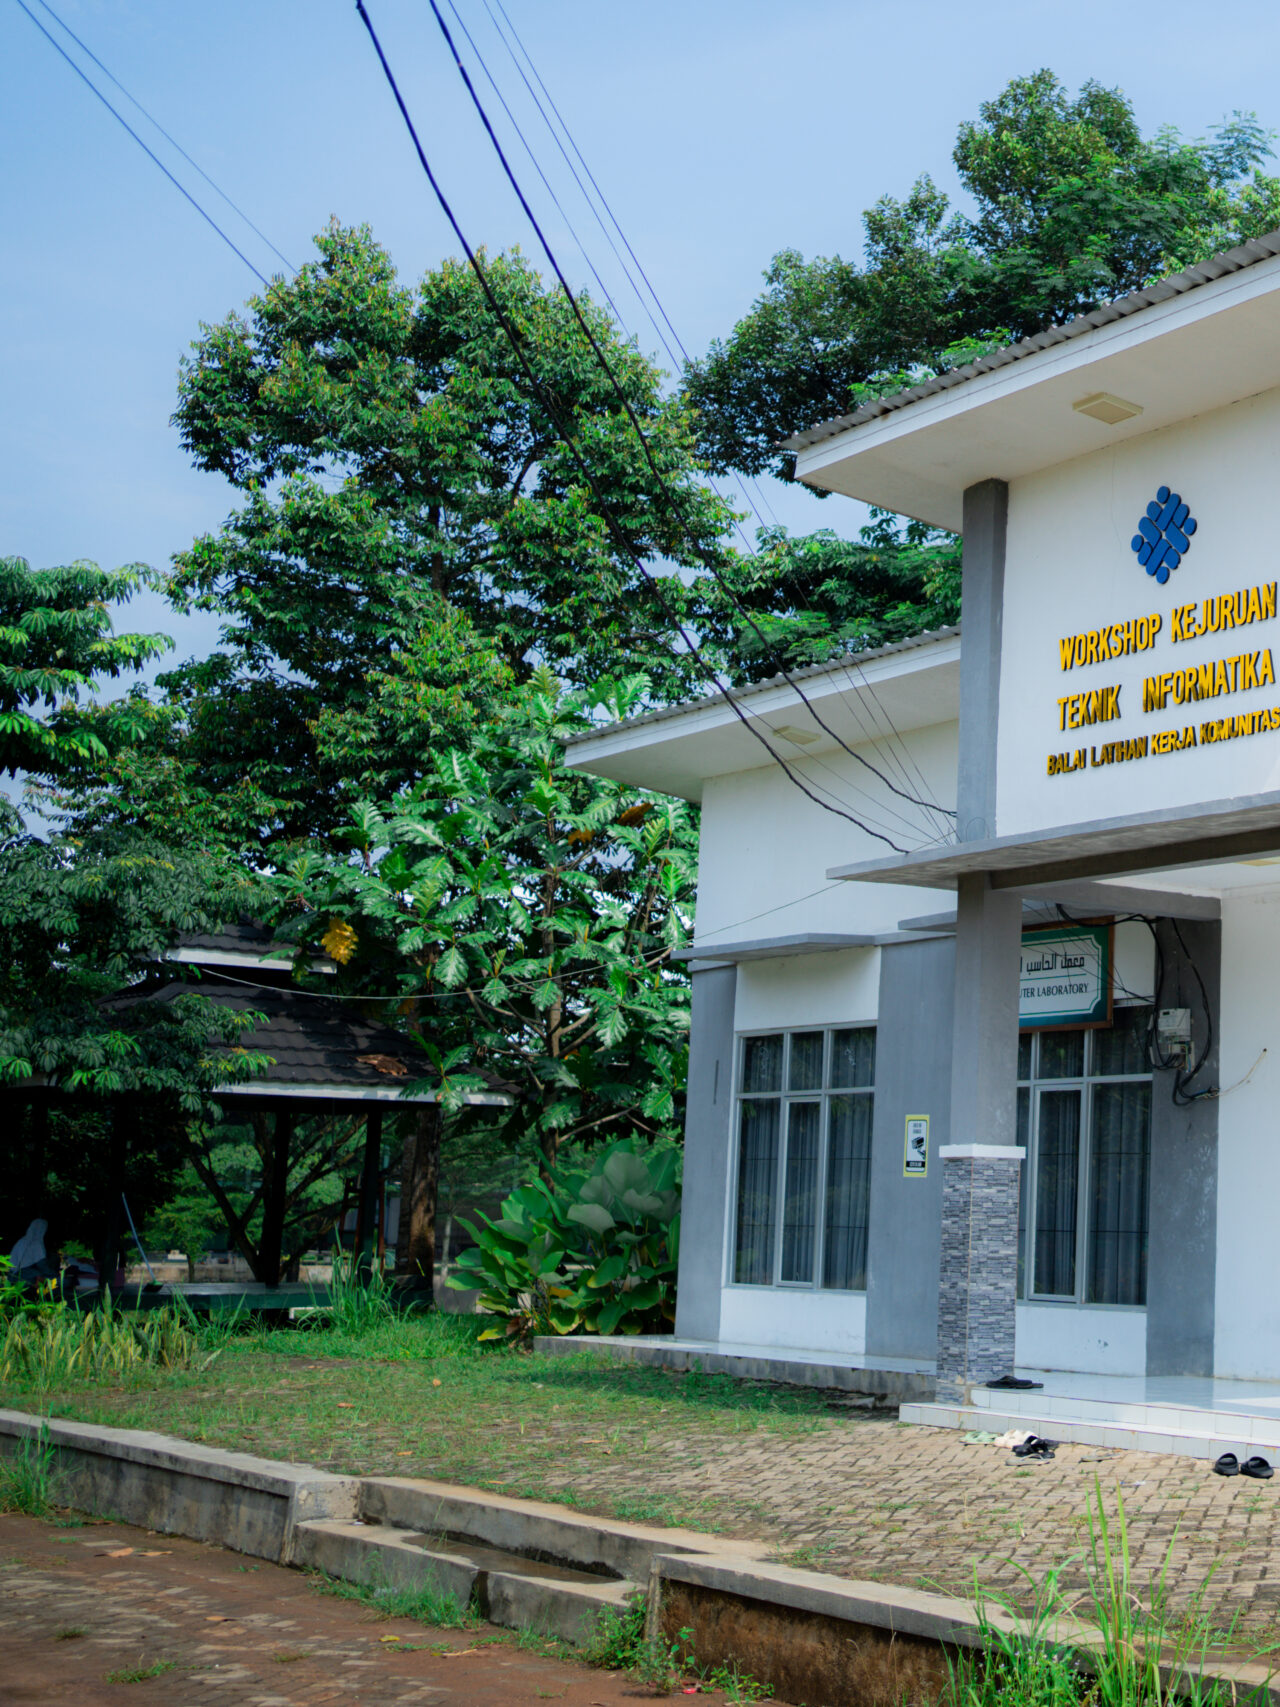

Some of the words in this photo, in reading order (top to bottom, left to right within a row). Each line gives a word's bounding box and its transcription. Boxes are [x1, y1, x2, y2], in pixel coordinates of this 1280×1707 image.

[1059, 613, 1162, 671] WORKSHOP
[1171, 581, 1277, 642] KEJURUAN
[1057, 684, 1121, 731] TEKNIK
[1142, 648, 1276, 713] INFORMATIKA
[1047, 748, 1087, 776] BALAI
[1091, 736, 1148, 768] LATIHAN
[1151, 726, 1198, 755] KERJA
[1037, 983, 1089, 998] LABORATORY
